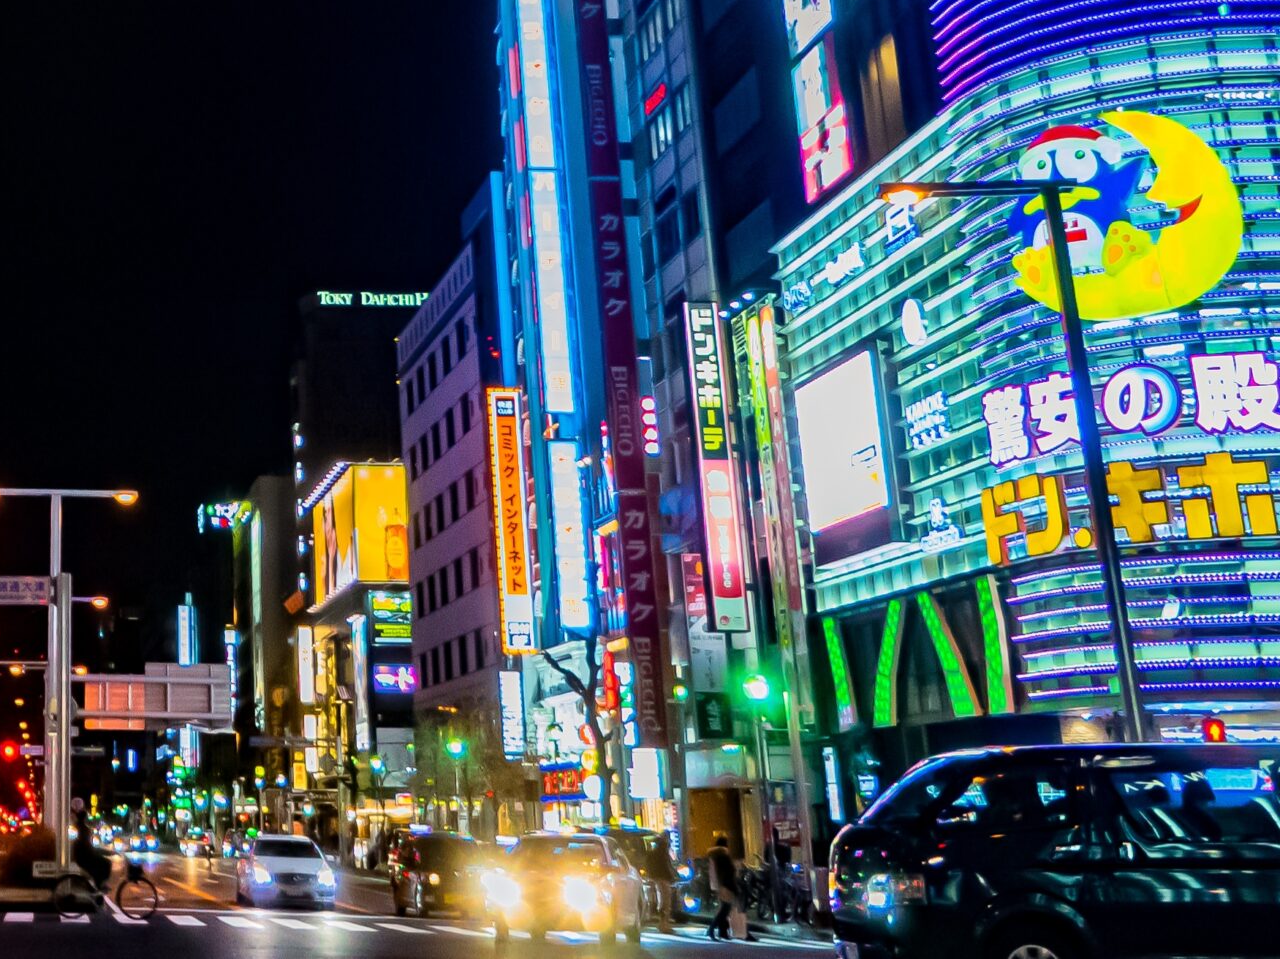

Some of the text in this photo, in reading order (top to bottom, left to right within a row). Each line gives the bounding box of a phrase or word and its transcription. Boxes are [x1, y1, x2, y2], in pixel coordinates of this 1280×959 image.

[599, 213, 627, 316] カラオケ
[624, 509, 655, 622] カラオケ
